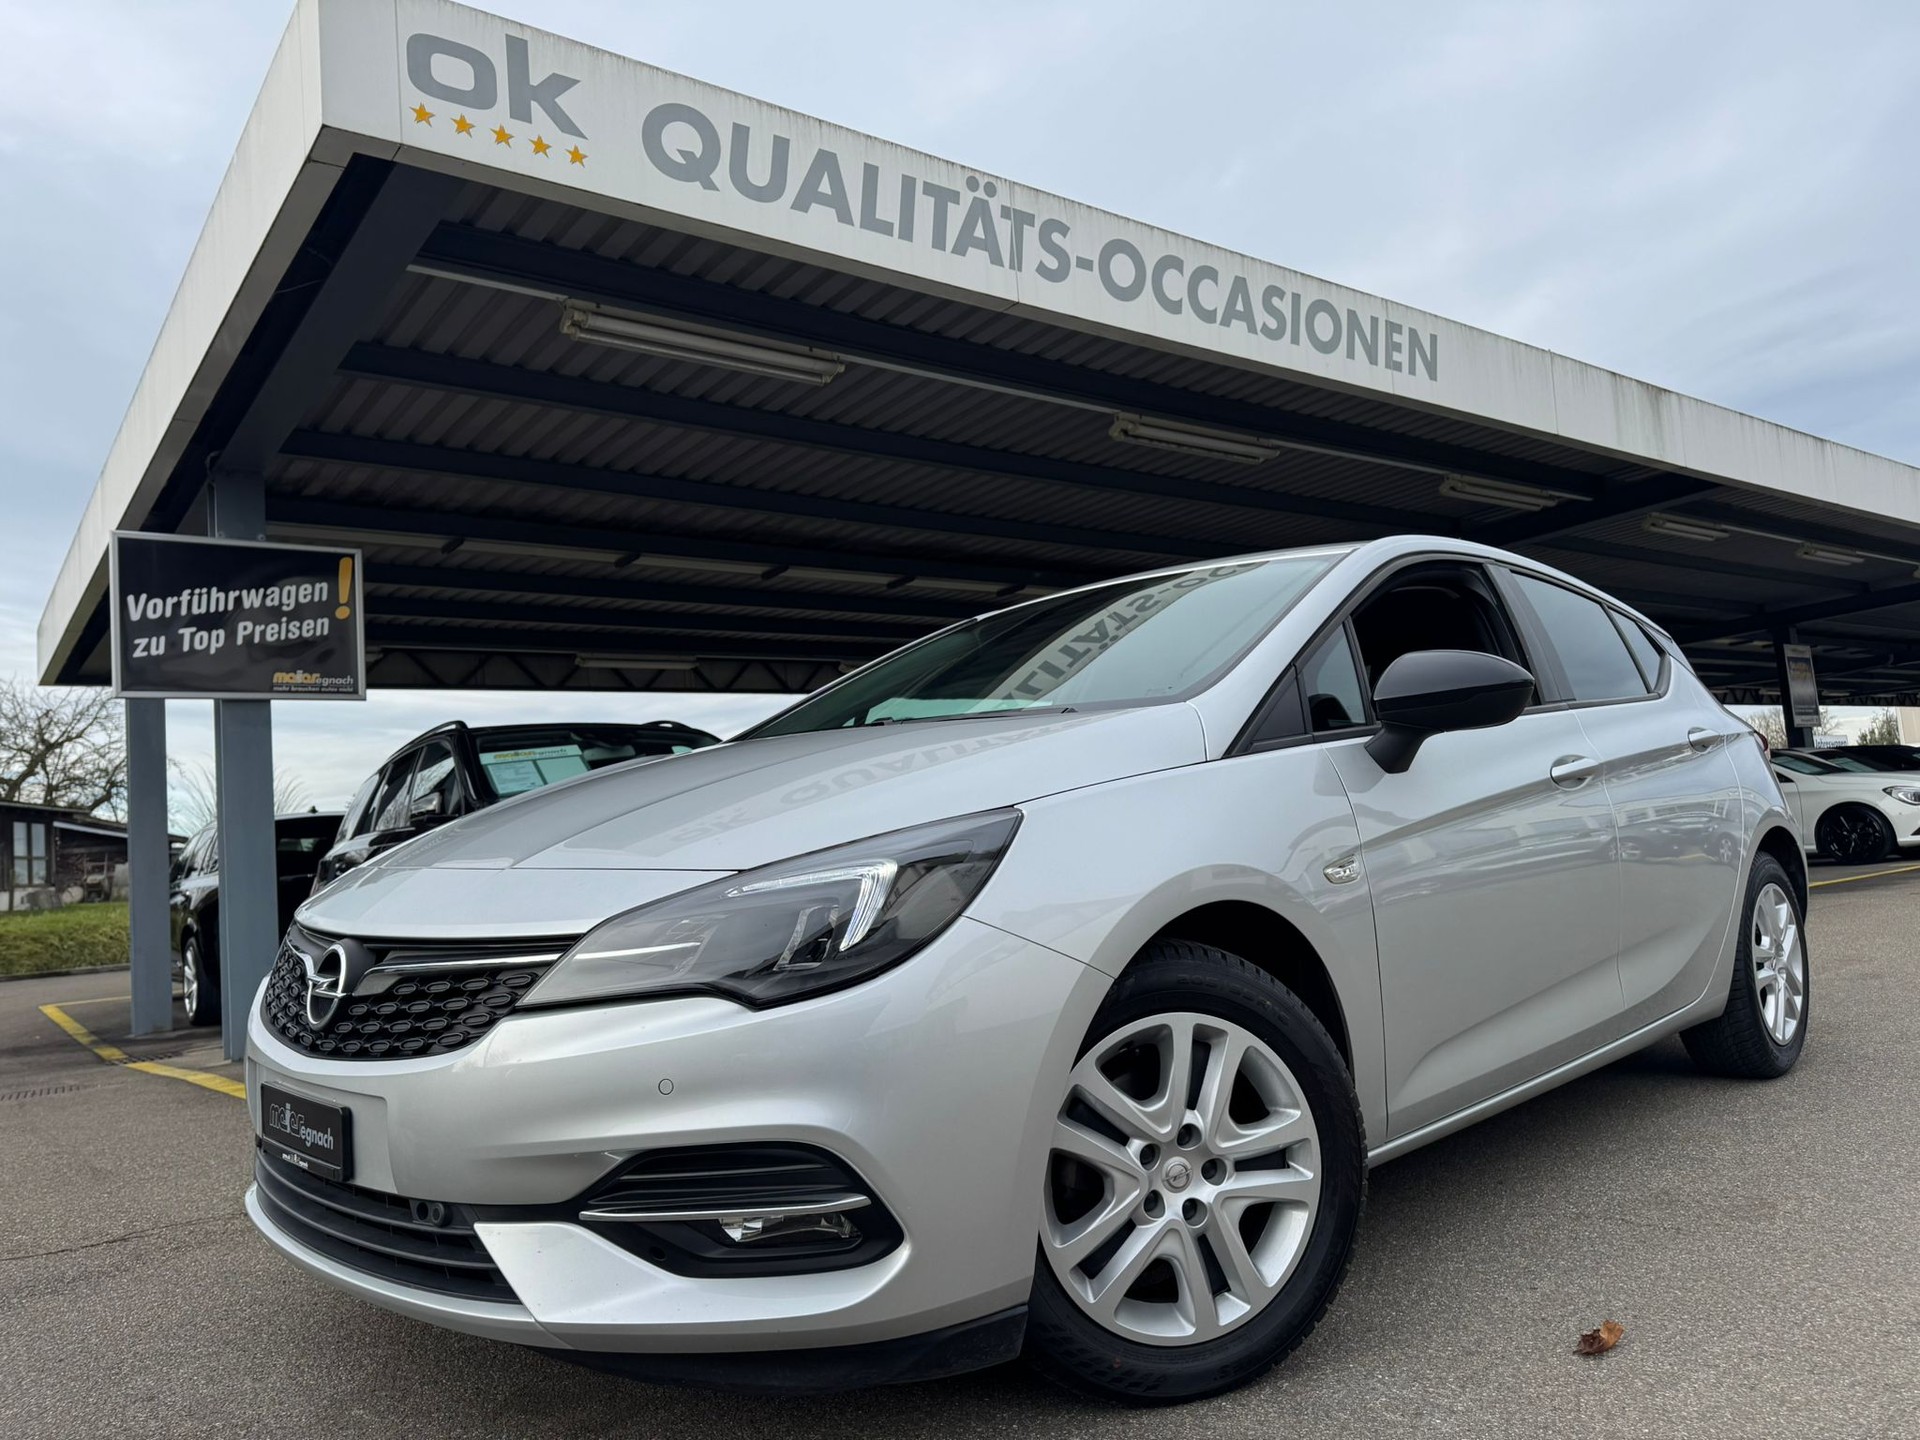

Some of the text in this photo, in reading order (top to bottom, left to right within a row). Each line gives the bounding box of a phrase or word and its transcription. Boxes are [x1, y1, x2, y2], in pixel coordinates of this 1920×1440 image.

[405, 33, 1439, 382] ok QUALITÄTS-OCCASIONEN
[127, 581, 329, 622] Vorführwagen
[132, 616, 329, 658] zu Top Preisen
